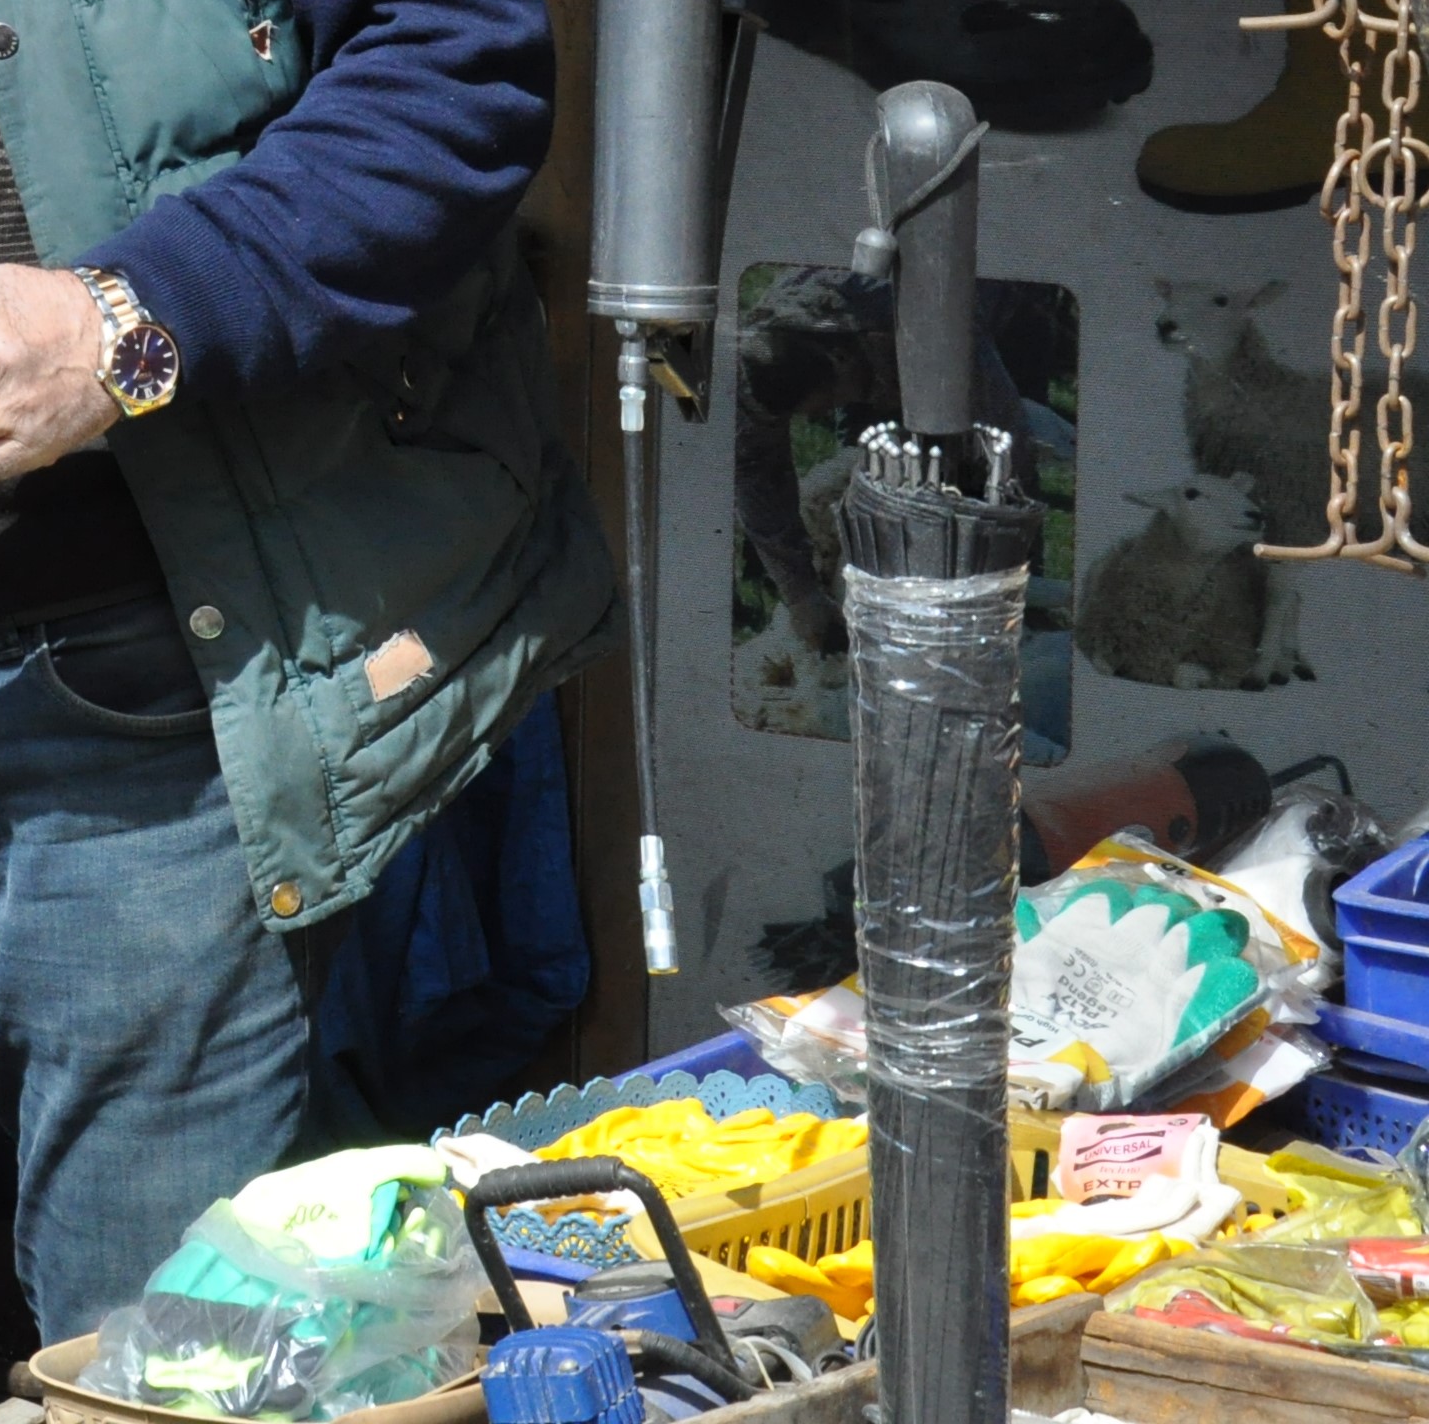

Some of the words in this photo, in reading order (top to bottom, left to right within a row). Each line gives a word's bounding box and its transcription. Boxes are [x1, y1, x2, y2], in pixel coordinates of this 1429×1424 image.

[1058, 977, 1118, 1018] Legend
[1061, 989, 1101, 1019] PL17
[1084, 1138, 1154, 1162] UNIVERSAL
